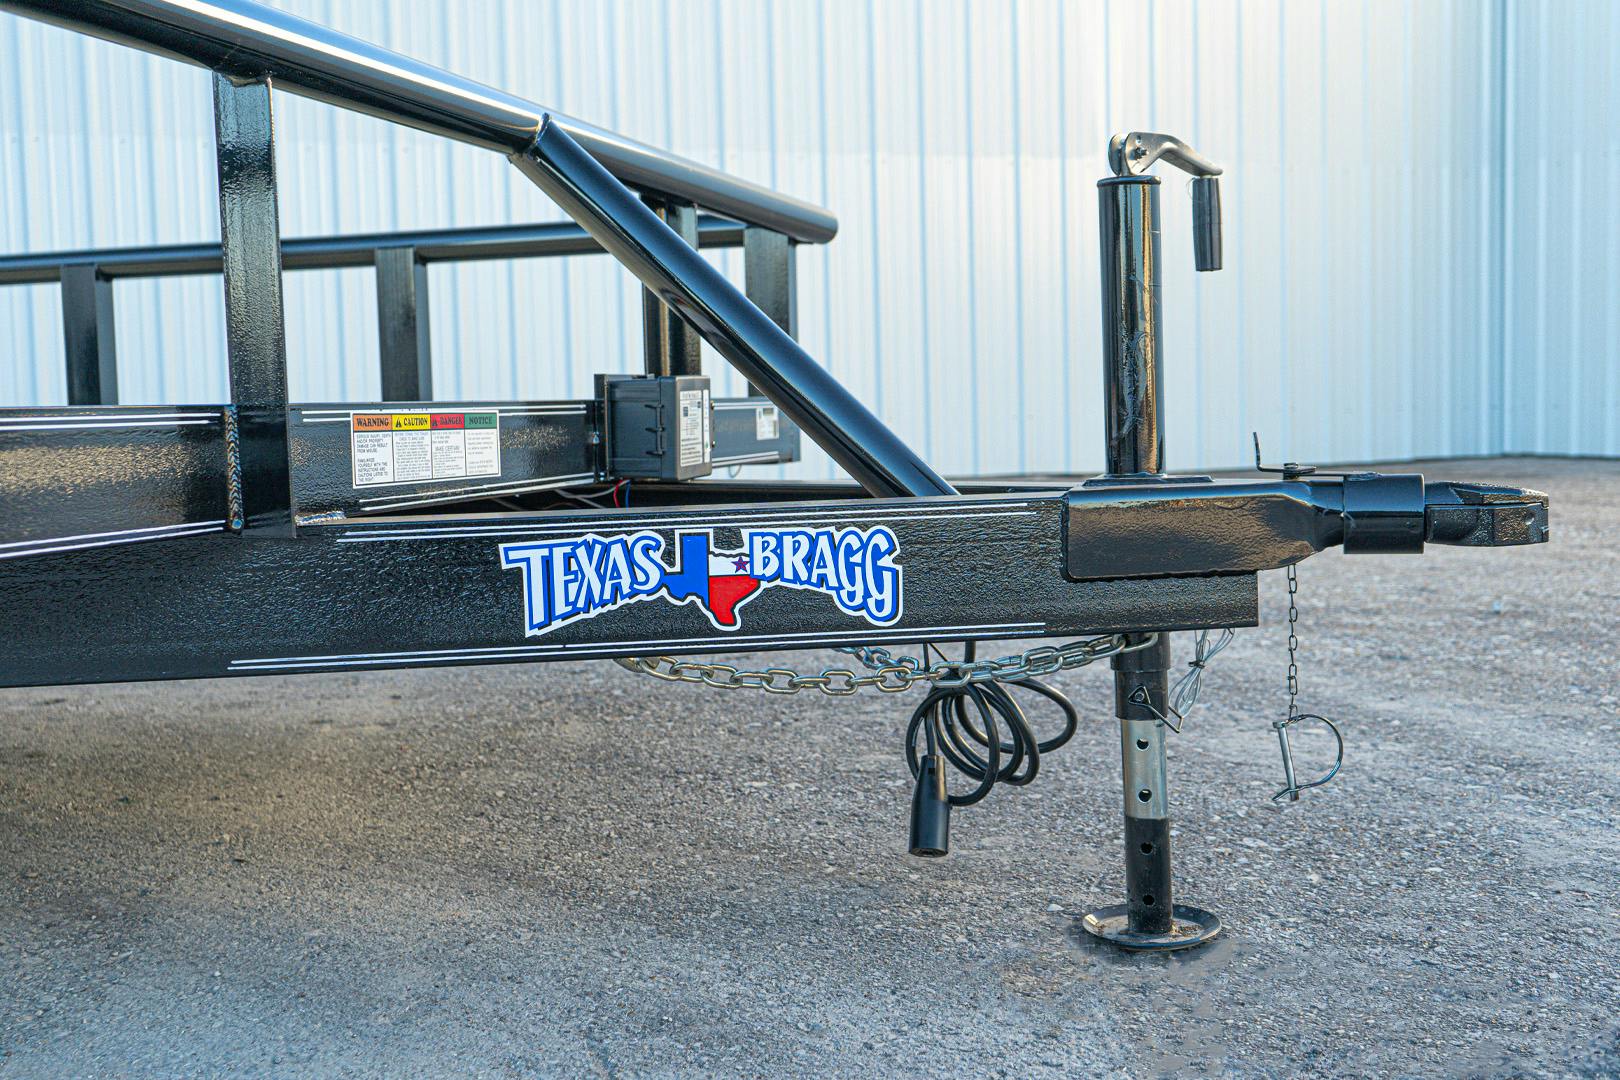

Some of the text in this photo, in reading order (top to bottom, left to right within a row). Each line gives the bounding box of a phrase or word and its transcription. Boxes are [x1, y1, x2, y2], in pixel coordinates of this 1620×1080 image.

[357, 418, 390, 426] WARNING
[404, 417, 428, 426] CAUTION
[440, 416, 462, 424] DANGER
[468, 416, 492, 424] NOTICE
[500, 528, 898, 634] TEXAS BRAGG
